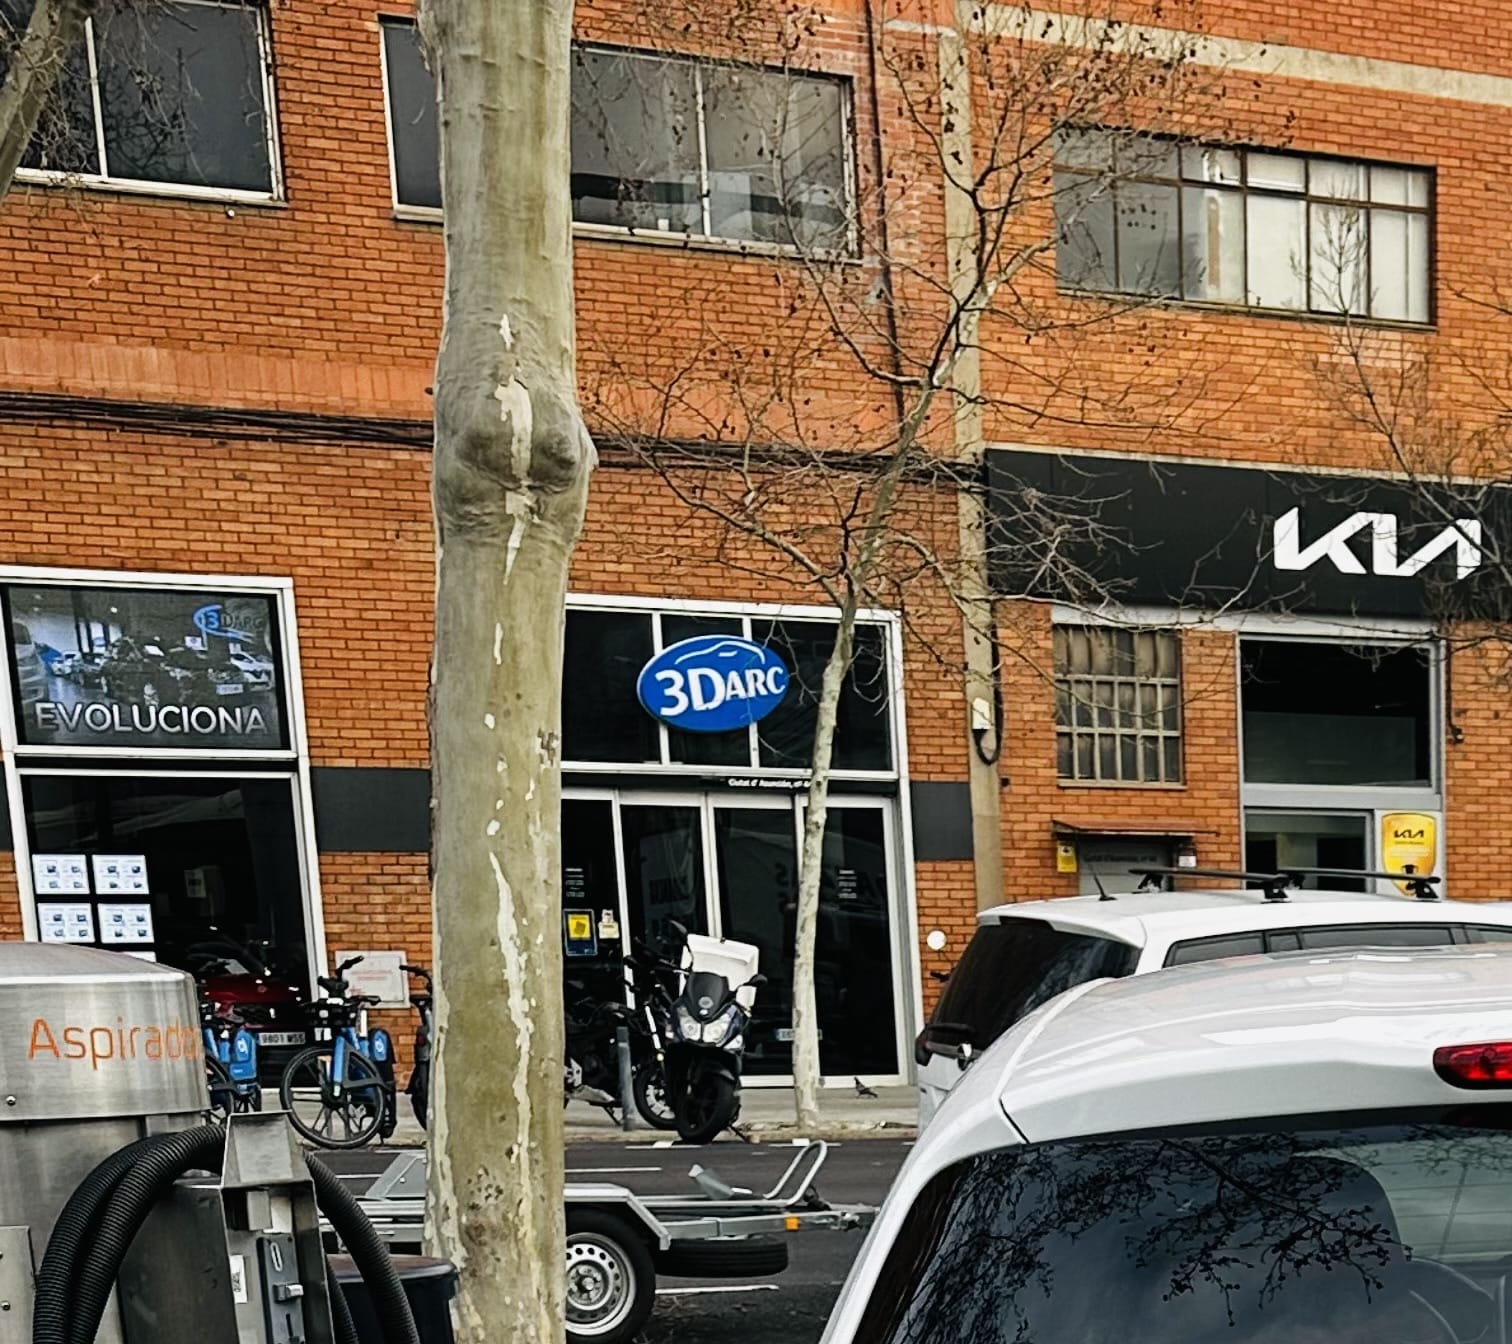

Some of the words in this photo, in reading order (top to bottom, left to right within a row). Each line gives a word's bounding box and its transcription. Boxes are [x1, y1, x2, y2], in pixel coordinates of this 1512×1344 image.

[654, 666, 787, 717] 3DARC
[35, 702, 269, 735] EVOLUCIONA
[27, 1016, 202, 1070] Aspirado
